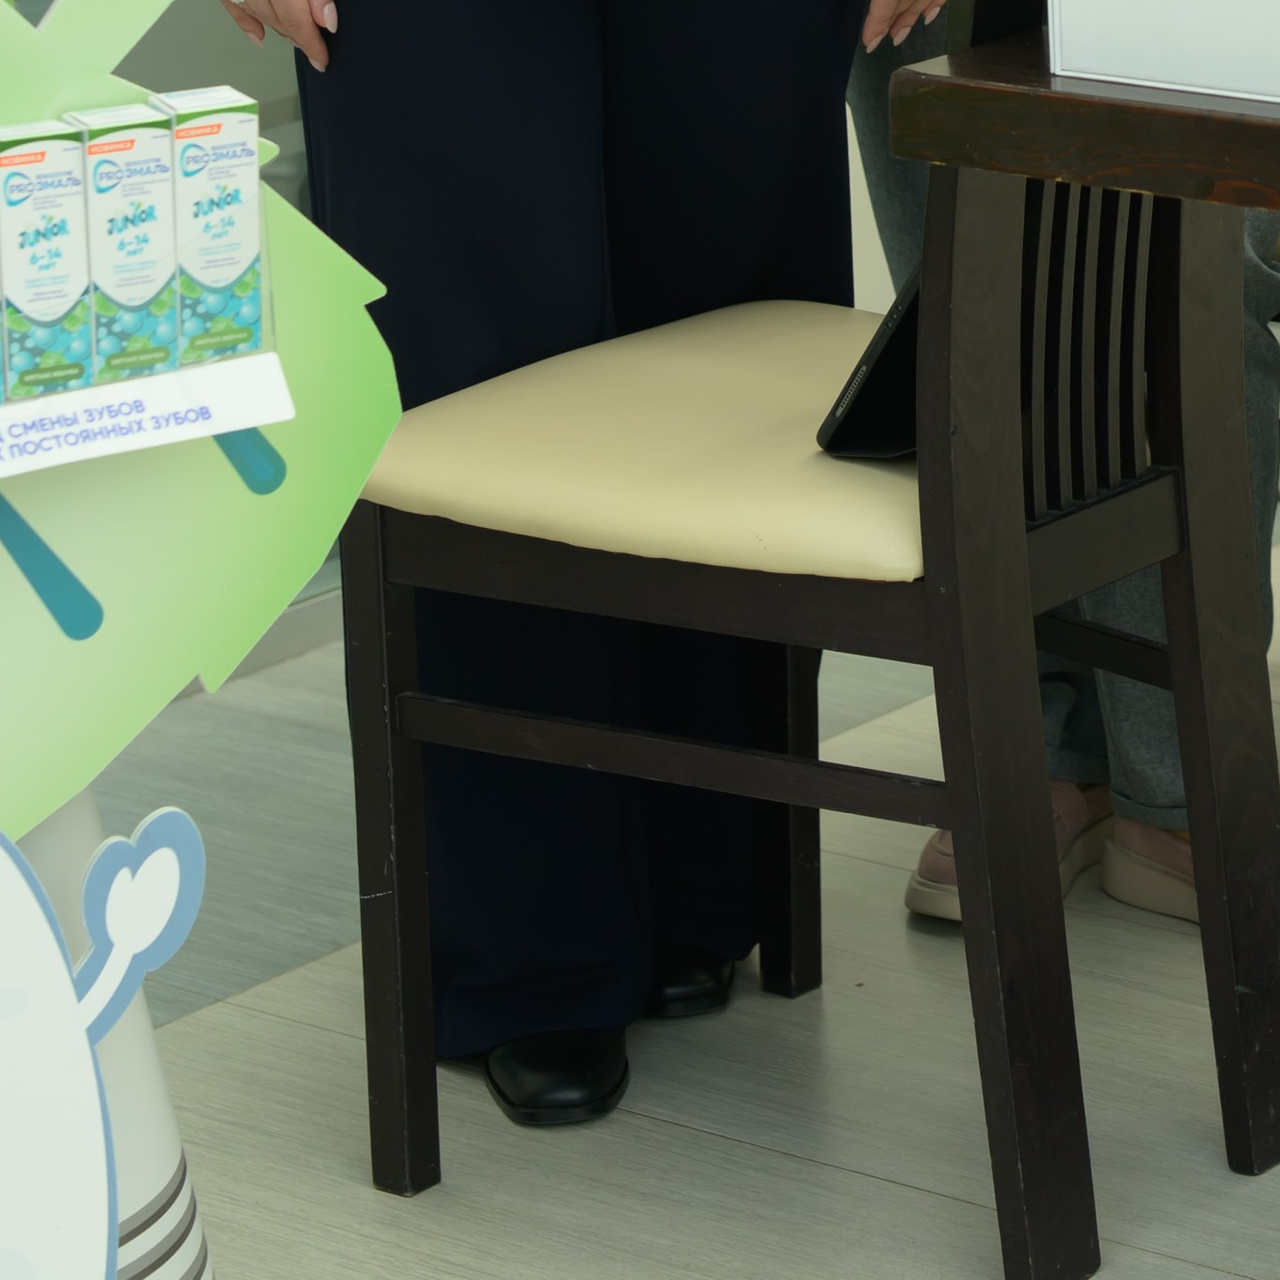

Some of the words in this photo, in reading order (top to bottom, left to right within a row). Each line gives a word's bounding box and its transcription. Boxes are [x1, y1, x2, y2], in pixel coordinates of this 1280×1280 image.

[8, 411, 79, 440] СМЕНЫ
[84, 398, 147, 424] ЗУБОВ
[9, 419, 147, 459] ПОСТОЯННЫХ
[150, 405, 213, 431] ЗУБОВ
